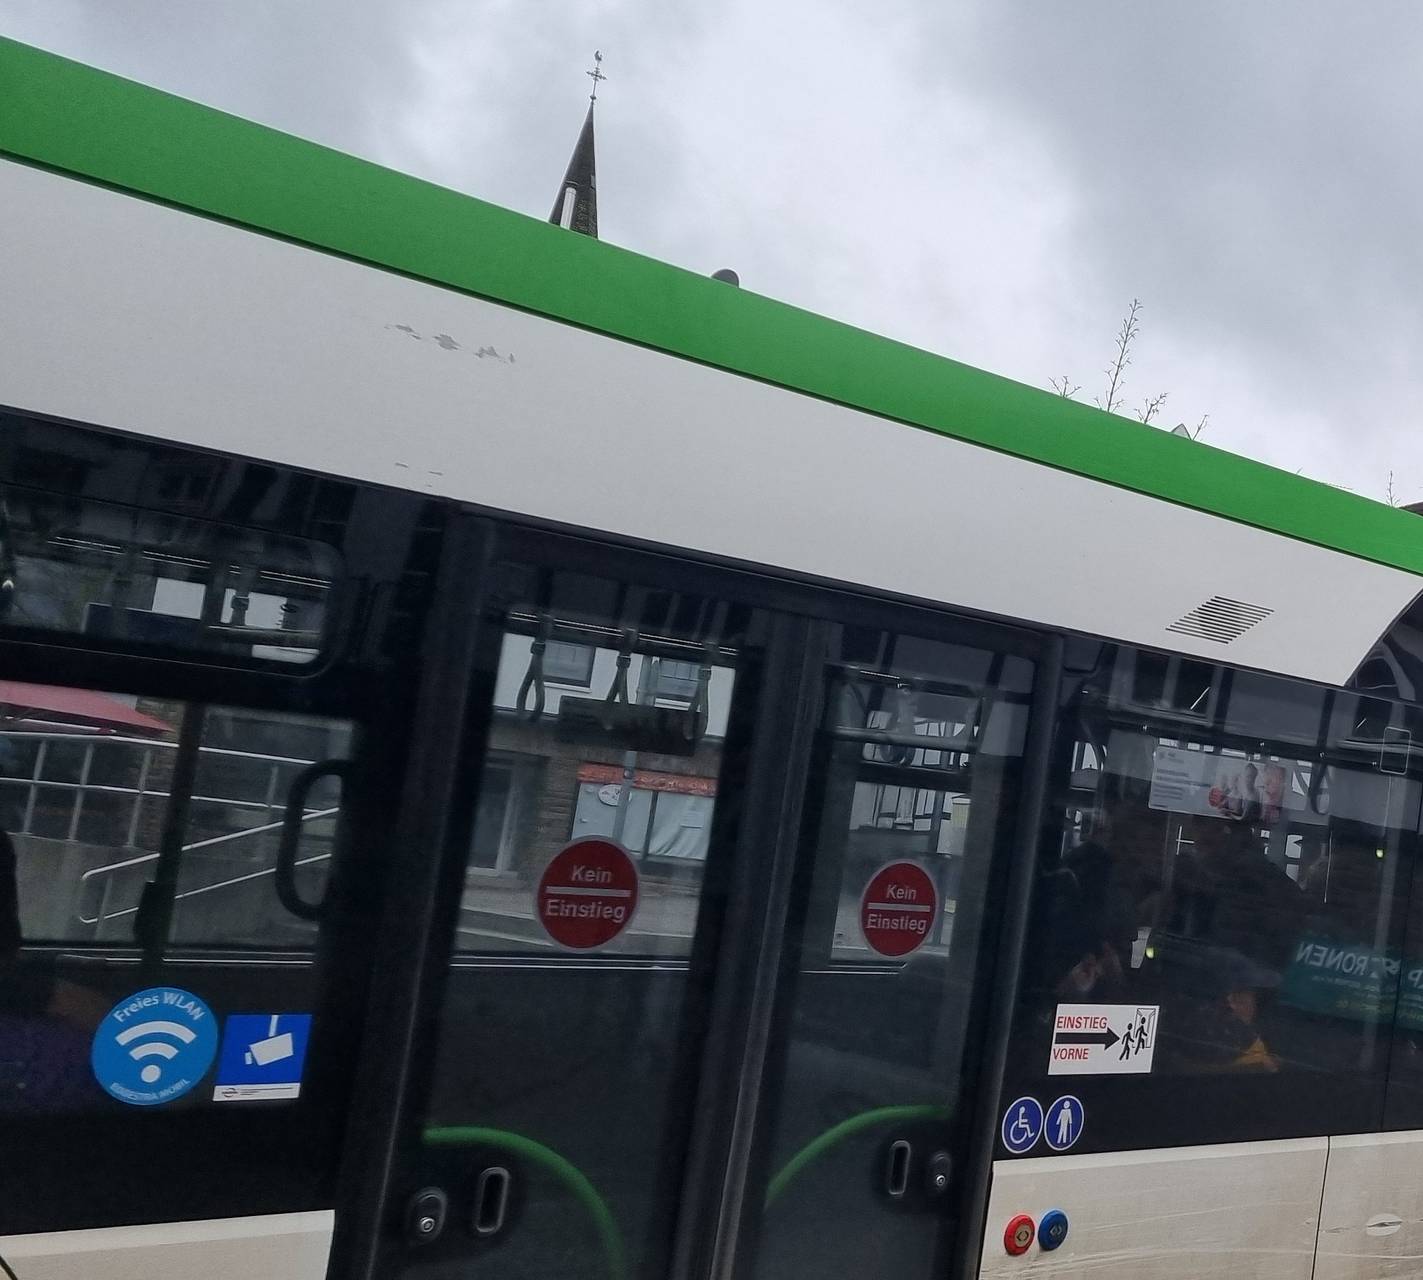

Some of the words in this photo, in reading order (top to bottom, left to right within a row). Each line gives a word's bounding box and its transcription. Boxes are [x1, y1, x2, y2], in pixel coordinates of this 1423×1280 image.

[571, 864, 612, 884] Kein
[886, 884, 917, 901] Kein
[546, 899, 626, 923] Einstieg
[867, 913, 927, 934] Einstieg
[113, 995, 159, 1022] Freies
[163, 992, 205, 1020] WLAN
[1057, 1016, 1108, 1030] EINSTIEG
[1053, 1048, 1089, 1061] VORNE
